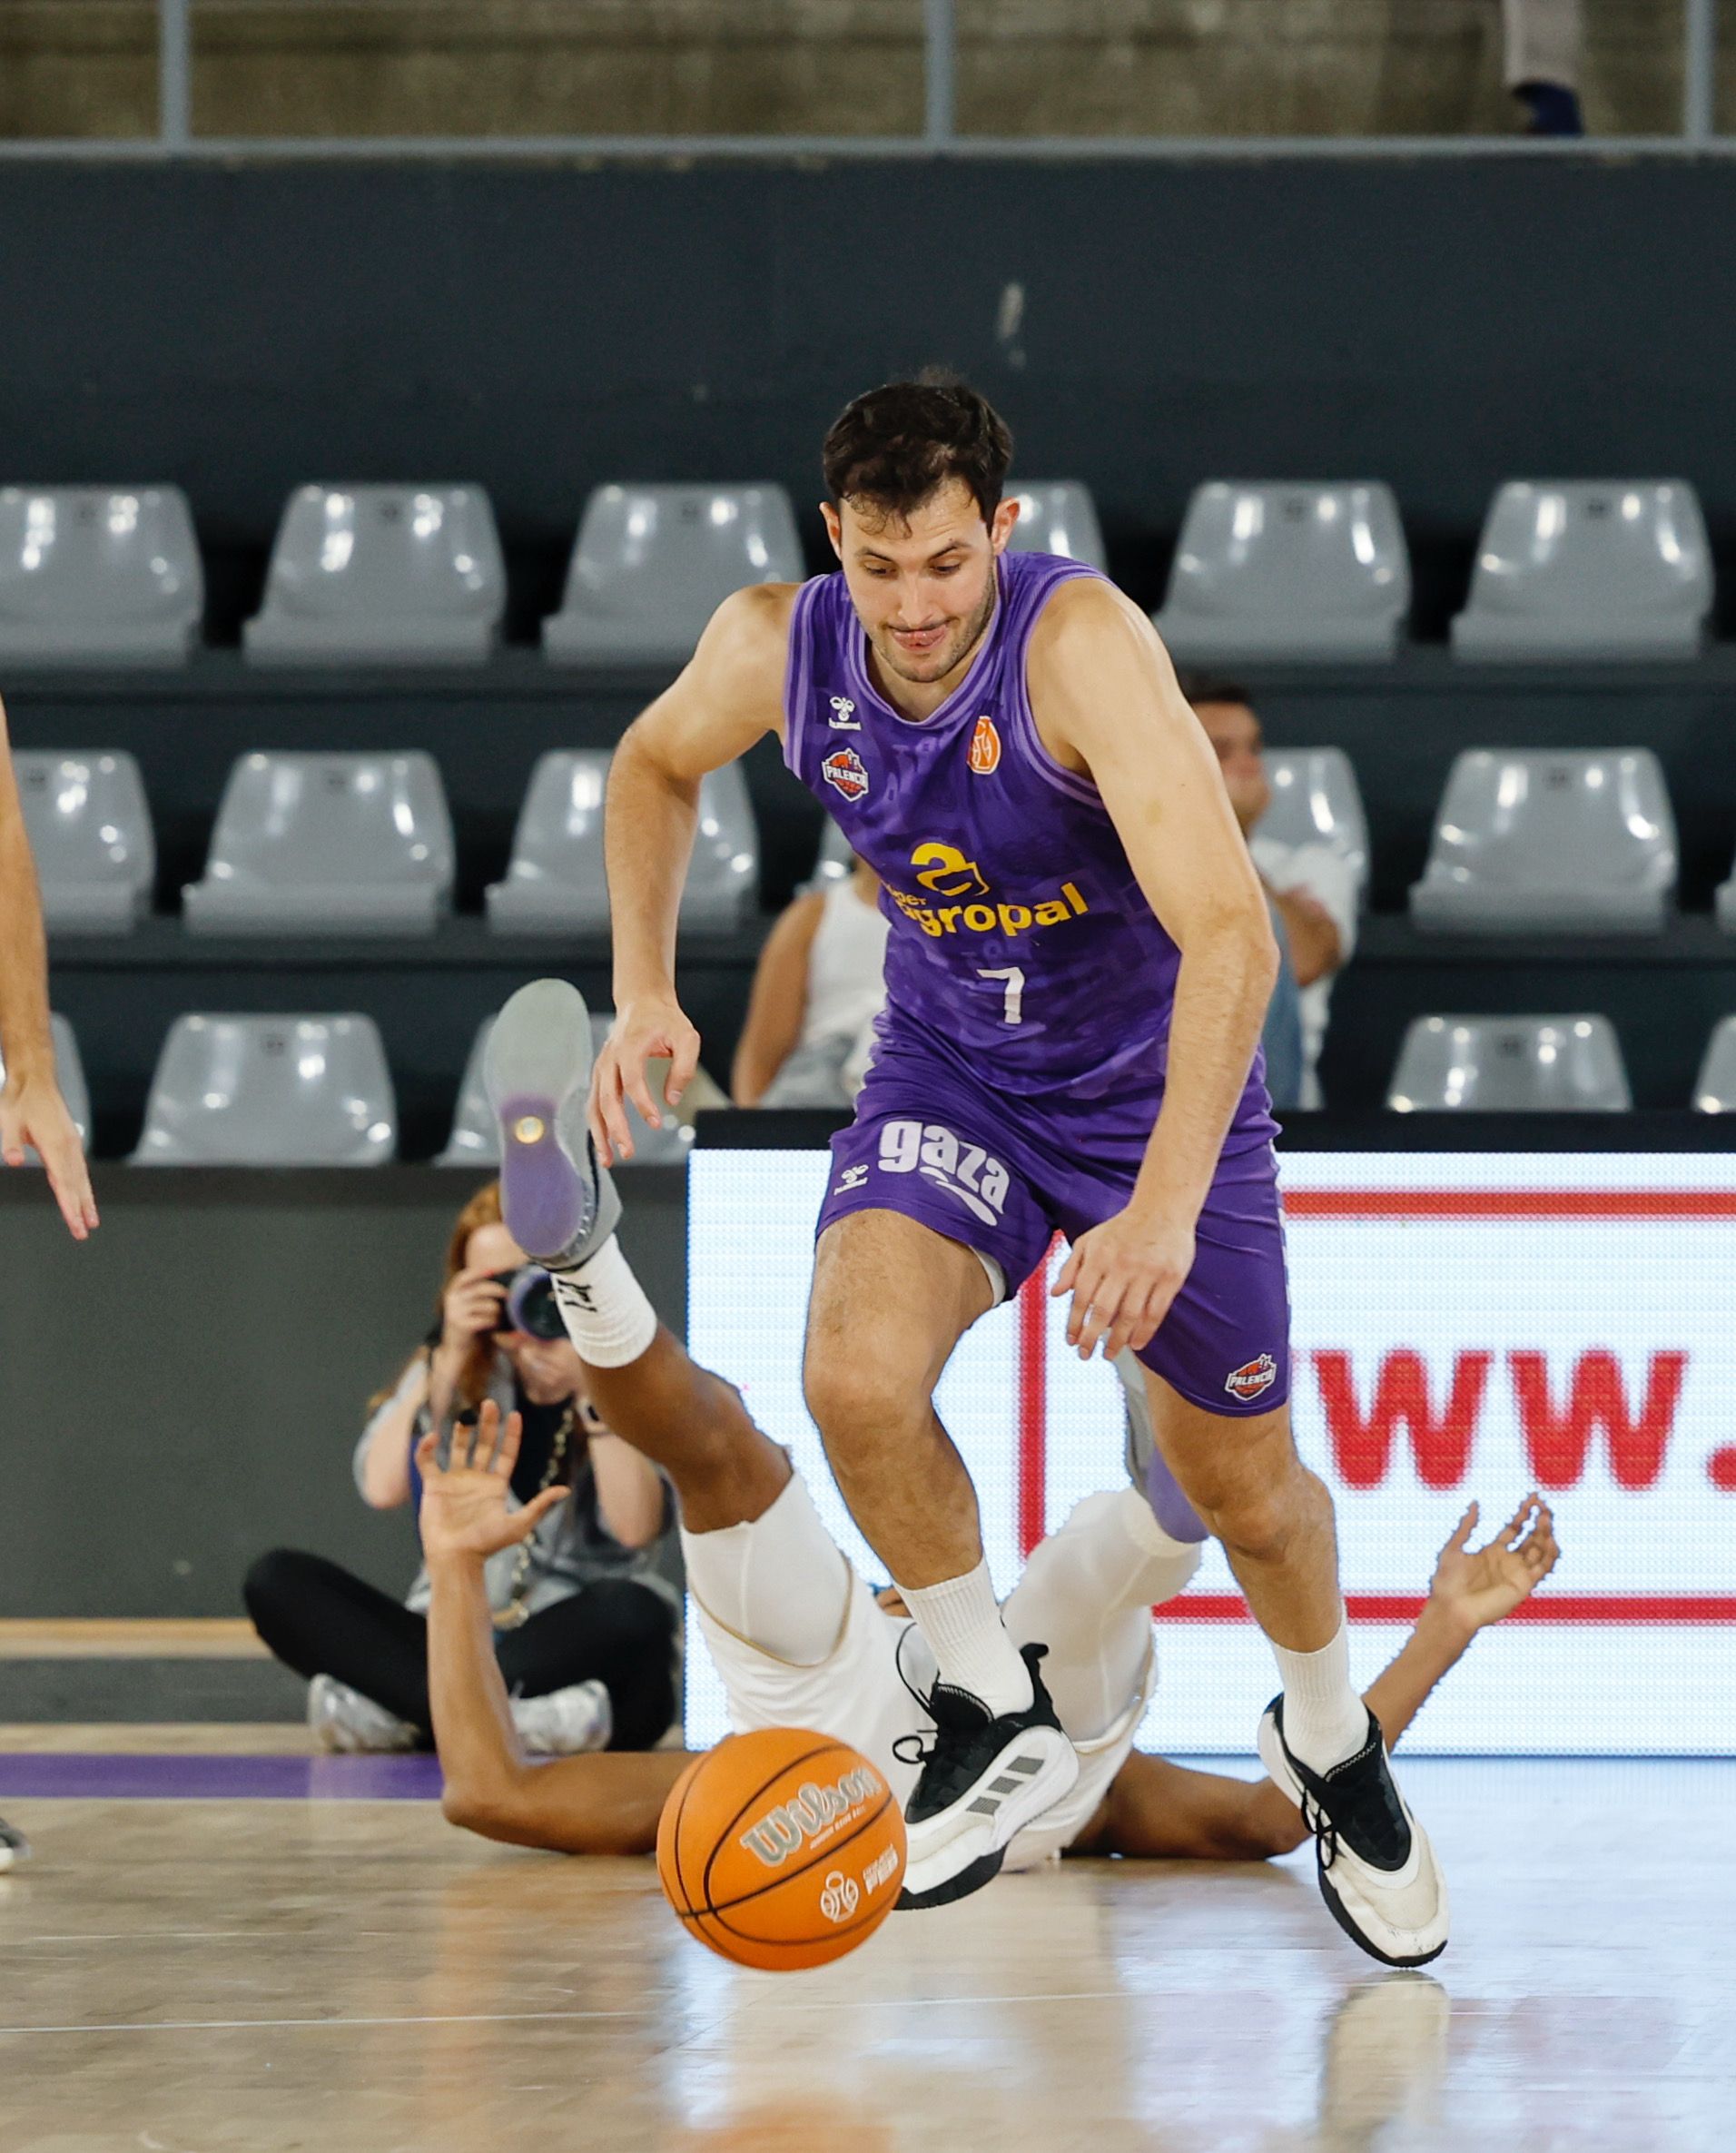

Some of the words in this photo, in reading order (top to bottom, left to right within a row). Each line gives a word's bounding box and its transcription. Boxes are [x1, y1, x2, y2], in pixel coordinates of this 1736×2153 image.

[976, 966, 1025, 1024] 7
[878, 1121, 1010, 1214] gaza
[740, 1767, 883, 1867] Wilson
